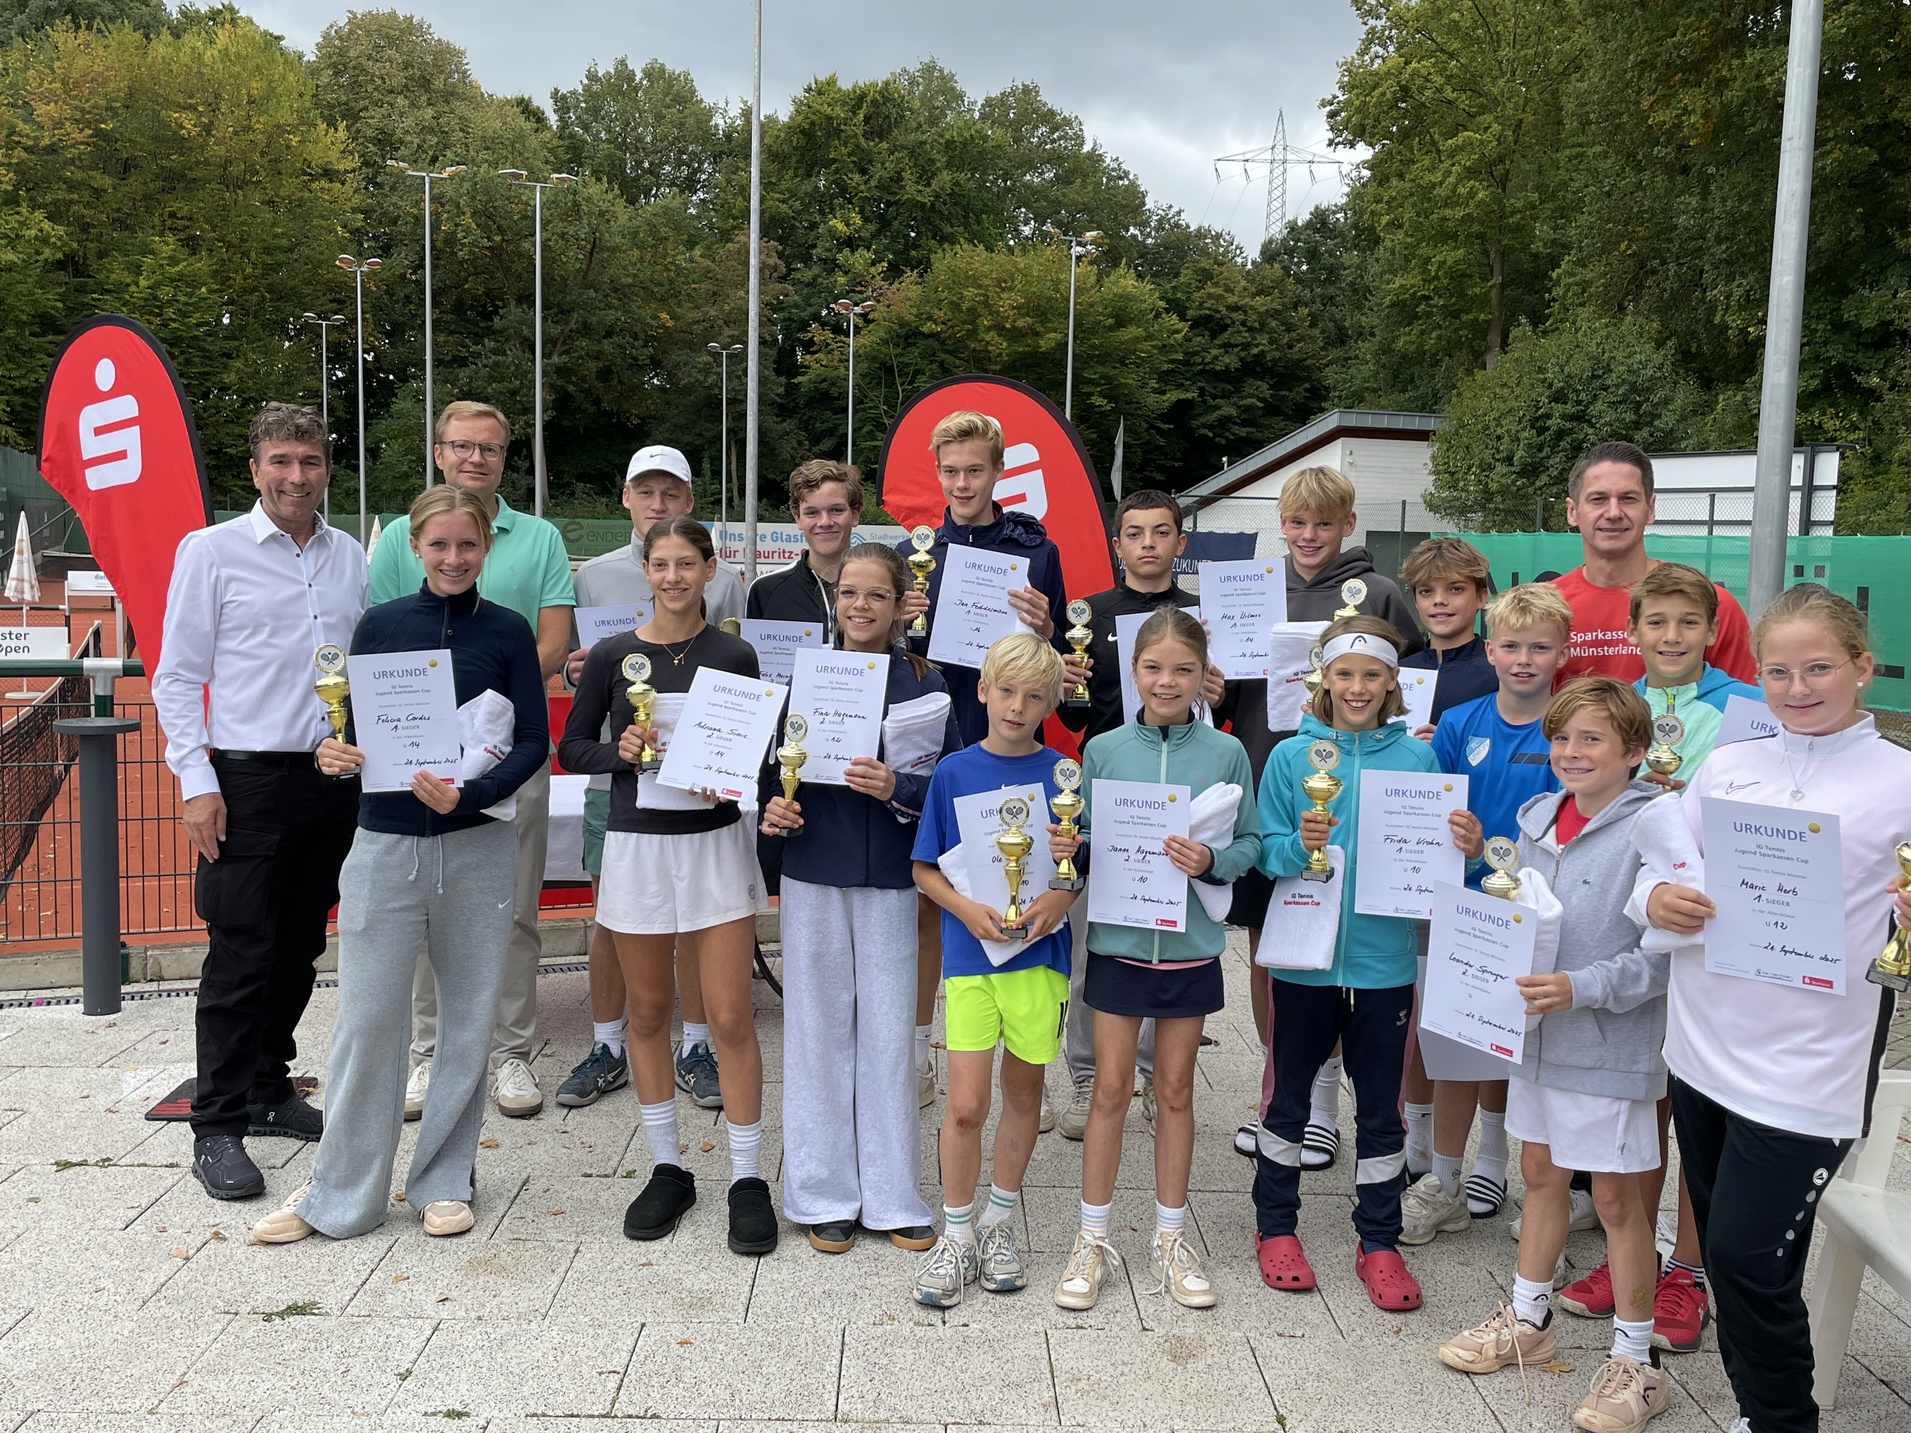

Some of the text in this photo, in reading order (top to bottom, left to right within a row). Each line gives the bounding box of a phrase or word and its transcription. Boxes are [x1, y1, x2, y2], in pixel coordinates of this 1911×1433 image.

[718, 530, 808, 543] Unsre Glasf
[718, 548, 808, 560] für auritz-
[964, 561, 1008, 576] URKUNDE
[1172, 558, 1199, 572] ZUKUN
[1220, 574, 1265, 584] URKUNDE
[594, 617, 637, 628] URKUNDE
[0, 630, 30, 641] ster
[760, 634, 804, 643] URKUNDE
[372, 668, 428, 680] URKUNDE
[816, 665, 865, 676] URKUNDE
[713, 684, 762, 702] URKUNDE
[1750, 720, 1778, 734] URK
[1470, 742, 1489, 762] UNION
[1385, 788, 1442, 800] URKUNDE
[1114, 798, 1166, 810] URKUNDE
[1734, 822, 1807, 842] URKUNDE
[1384, 834, 1412, 844] Frida
[1734, 848, 1757, 856] Jugend
[1758, 852, 1794, 862] Sparkassen
[1764, 845, 1786, 853] Tennis
[992, 854, 1002, 864] Ole
[1410, 866, 1422, 874] 10
[1137, 876, 1148, 884] 10
[1740, 878, 1766, 892] Marie
[1766, 898, 1790, 907] SIEGER
[1456, 904, 1511, 930] URKUNDE
[1774, 920, 1788, 930] 12
[1454, 927, 1509, 950] Jugend Sparkassen Cup
[1478, 928, 1493, 937] Tennis
[1472, 973, 1490, 984] SIEGER
